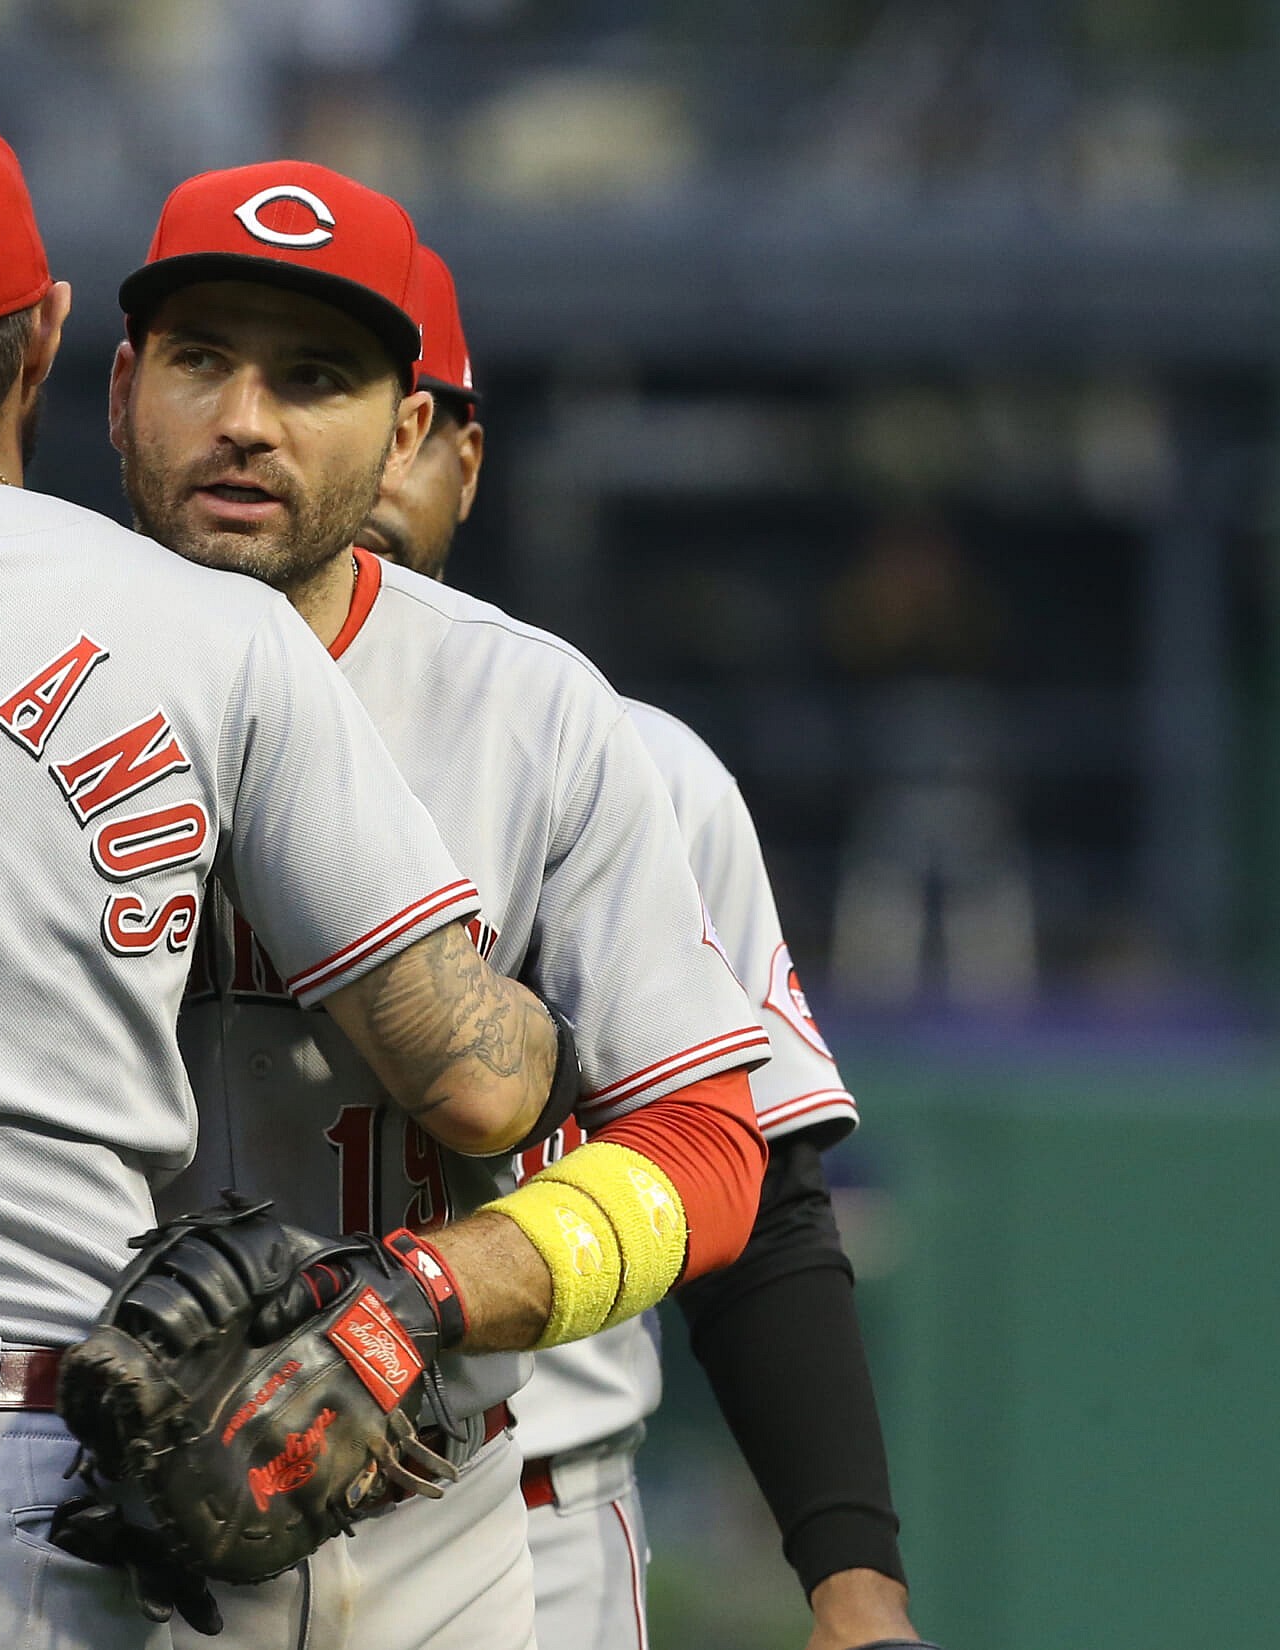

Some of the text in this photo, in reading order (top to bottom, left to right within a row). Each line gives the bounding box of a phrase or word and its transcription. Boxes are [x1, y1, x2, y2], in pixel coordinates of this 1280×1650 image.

[234, 184, 336, 250] C
[323, 1103, 454, 1236] 19
[347, 1320, 409, 1385] Rawlings
